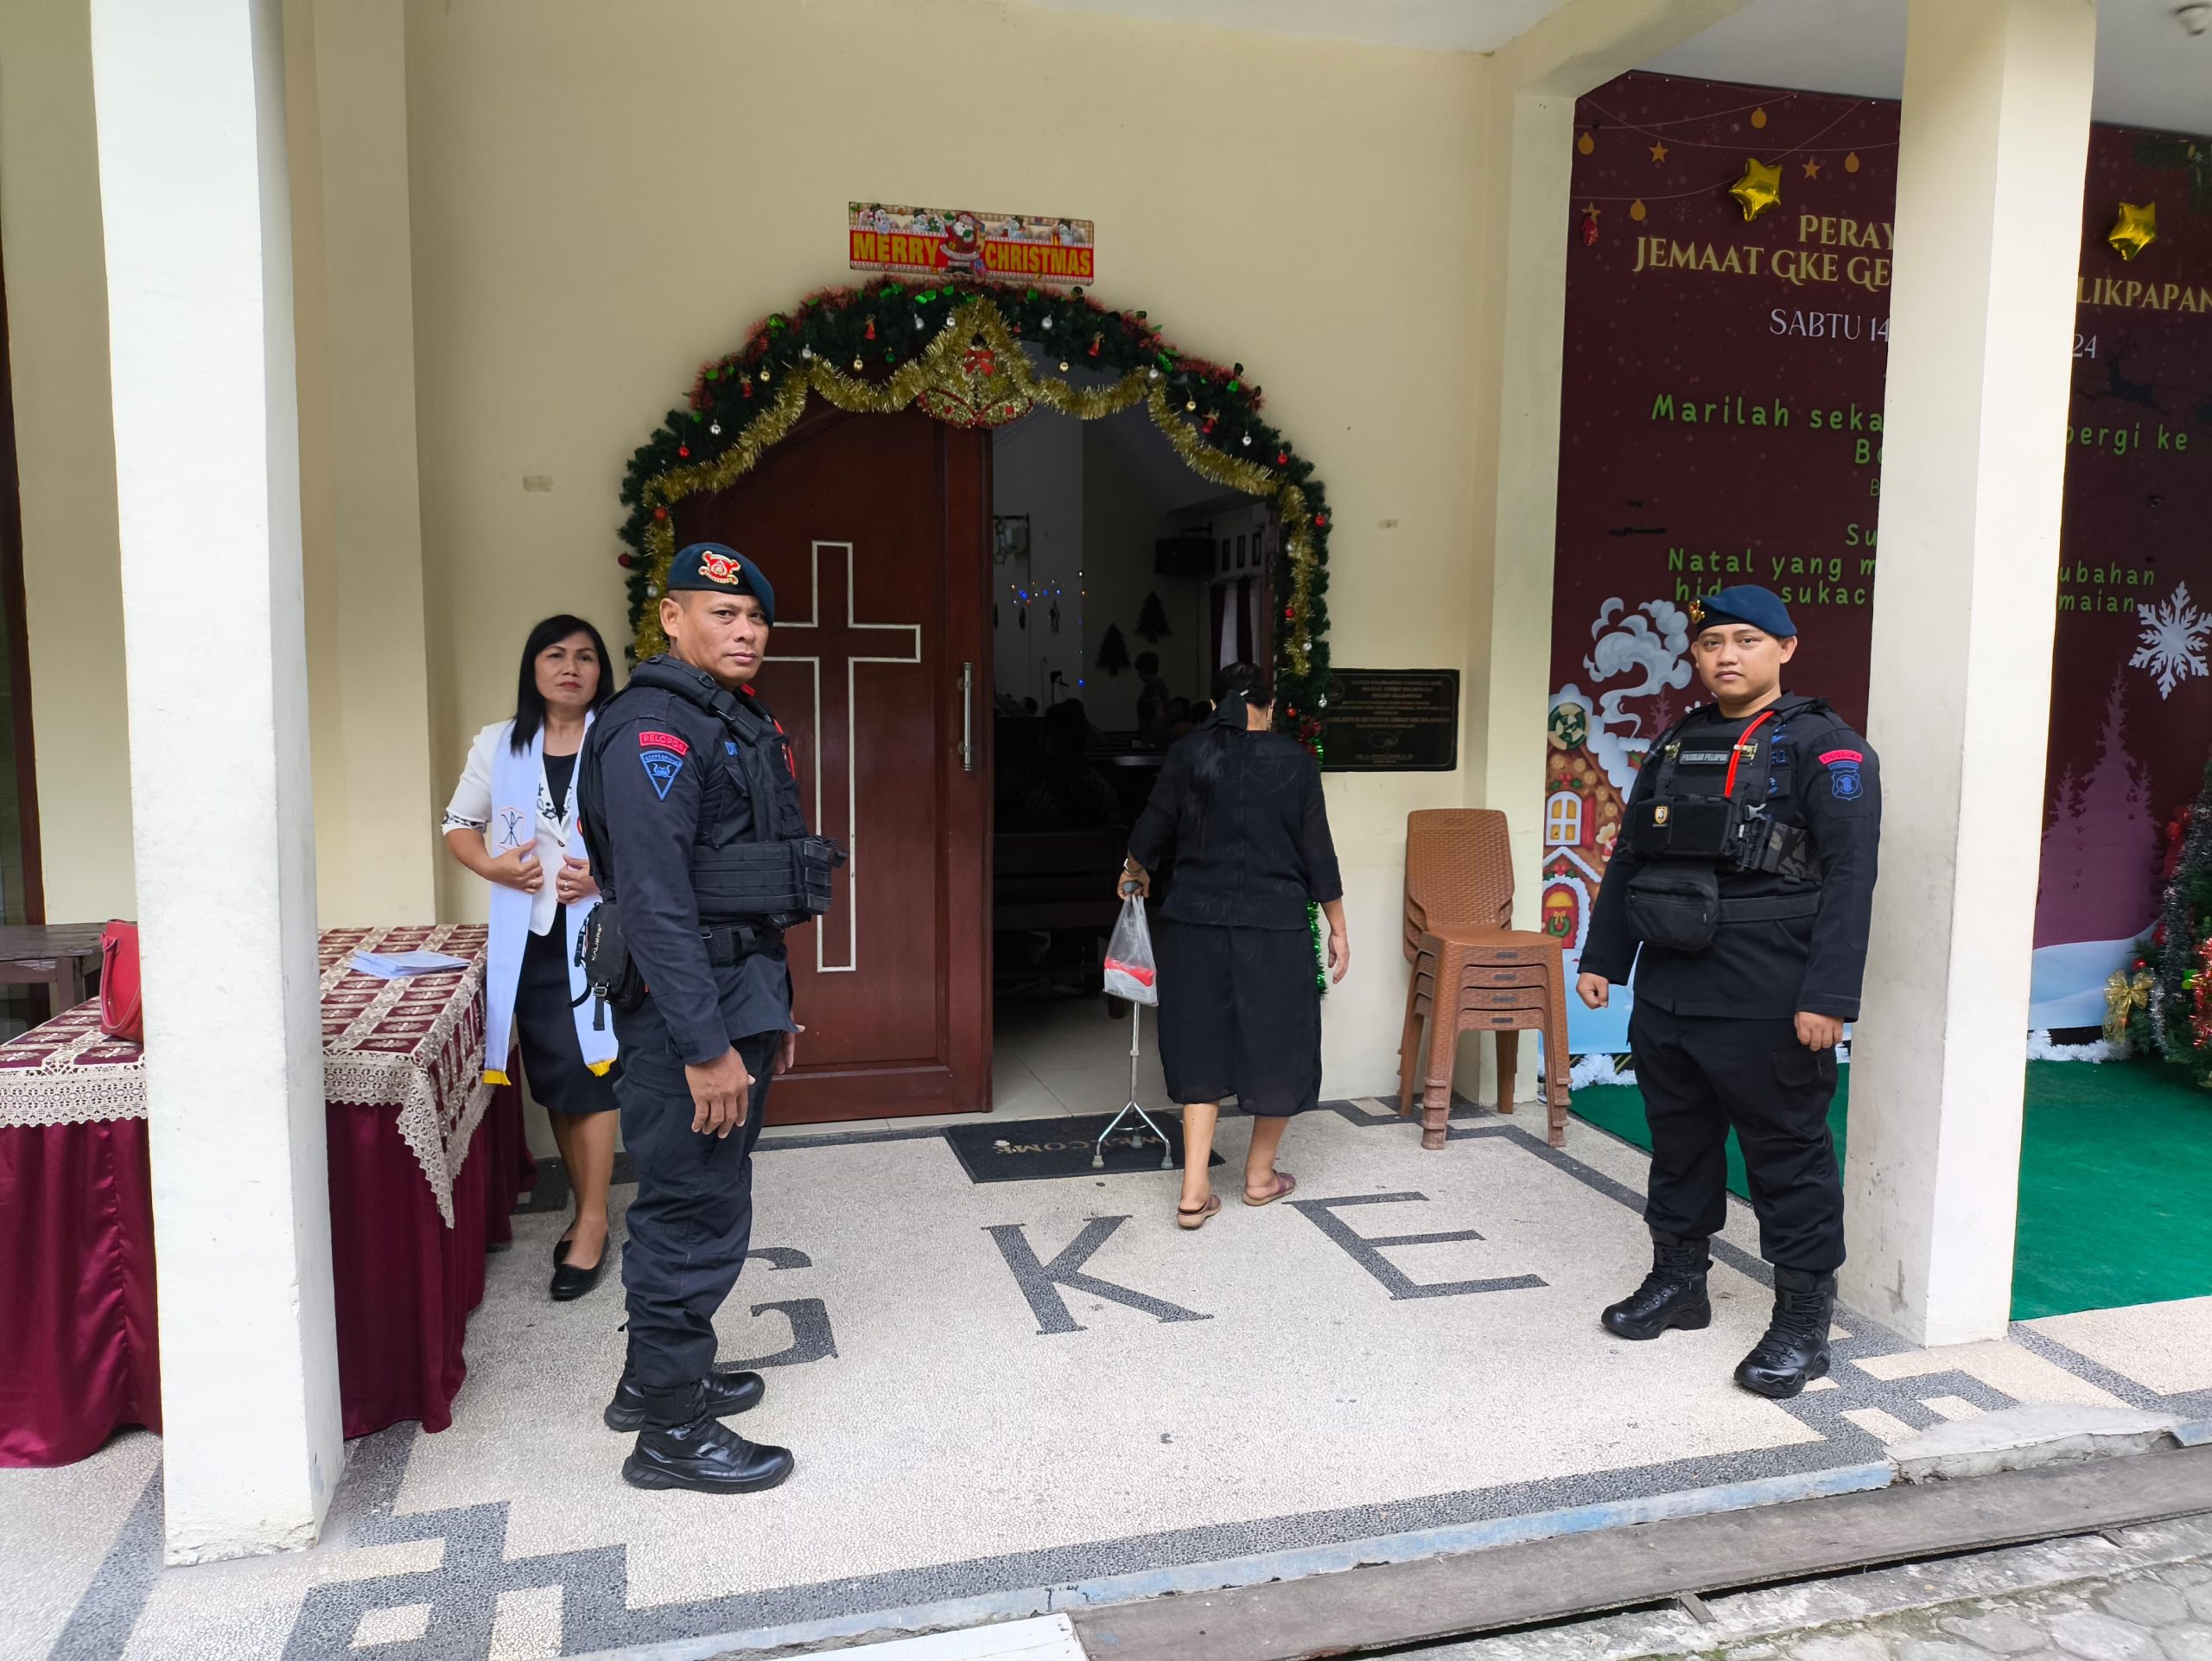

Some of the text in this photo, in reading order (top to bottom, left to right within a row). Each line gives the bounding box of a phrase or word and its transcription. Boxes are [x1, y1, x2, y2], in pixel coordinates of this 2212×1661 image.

[1797, 214, 1894, 250] PERAY
[853, 232, 1091, 277] MERRY CHRISTMAS
[1631, 236, 1764, 275] JEMAAT
[1771, 249, 1839, 286] GKE
[1847, 256, 1891, 292] GE
[1770, 308, 1860, 340] SABTU
[1870, 316, 1890, 342] 14
[1651, 393, 1789, 429] Marilah
[1809, 404, 1884, 432] seka
[2158, 423, 2189, 451] ke
[1669, 547, 1754, 573] Natal
[1771, 555, 1842, 582] yang
[2058, 560, 2155, 586] ubahan
[1782, 580, 1875, 604] sukac
[2058, 589, 2134, 613] maian
[643, 734, 684, 751] PELOPOR
[591, 925, 603, 961] KALIBRE
